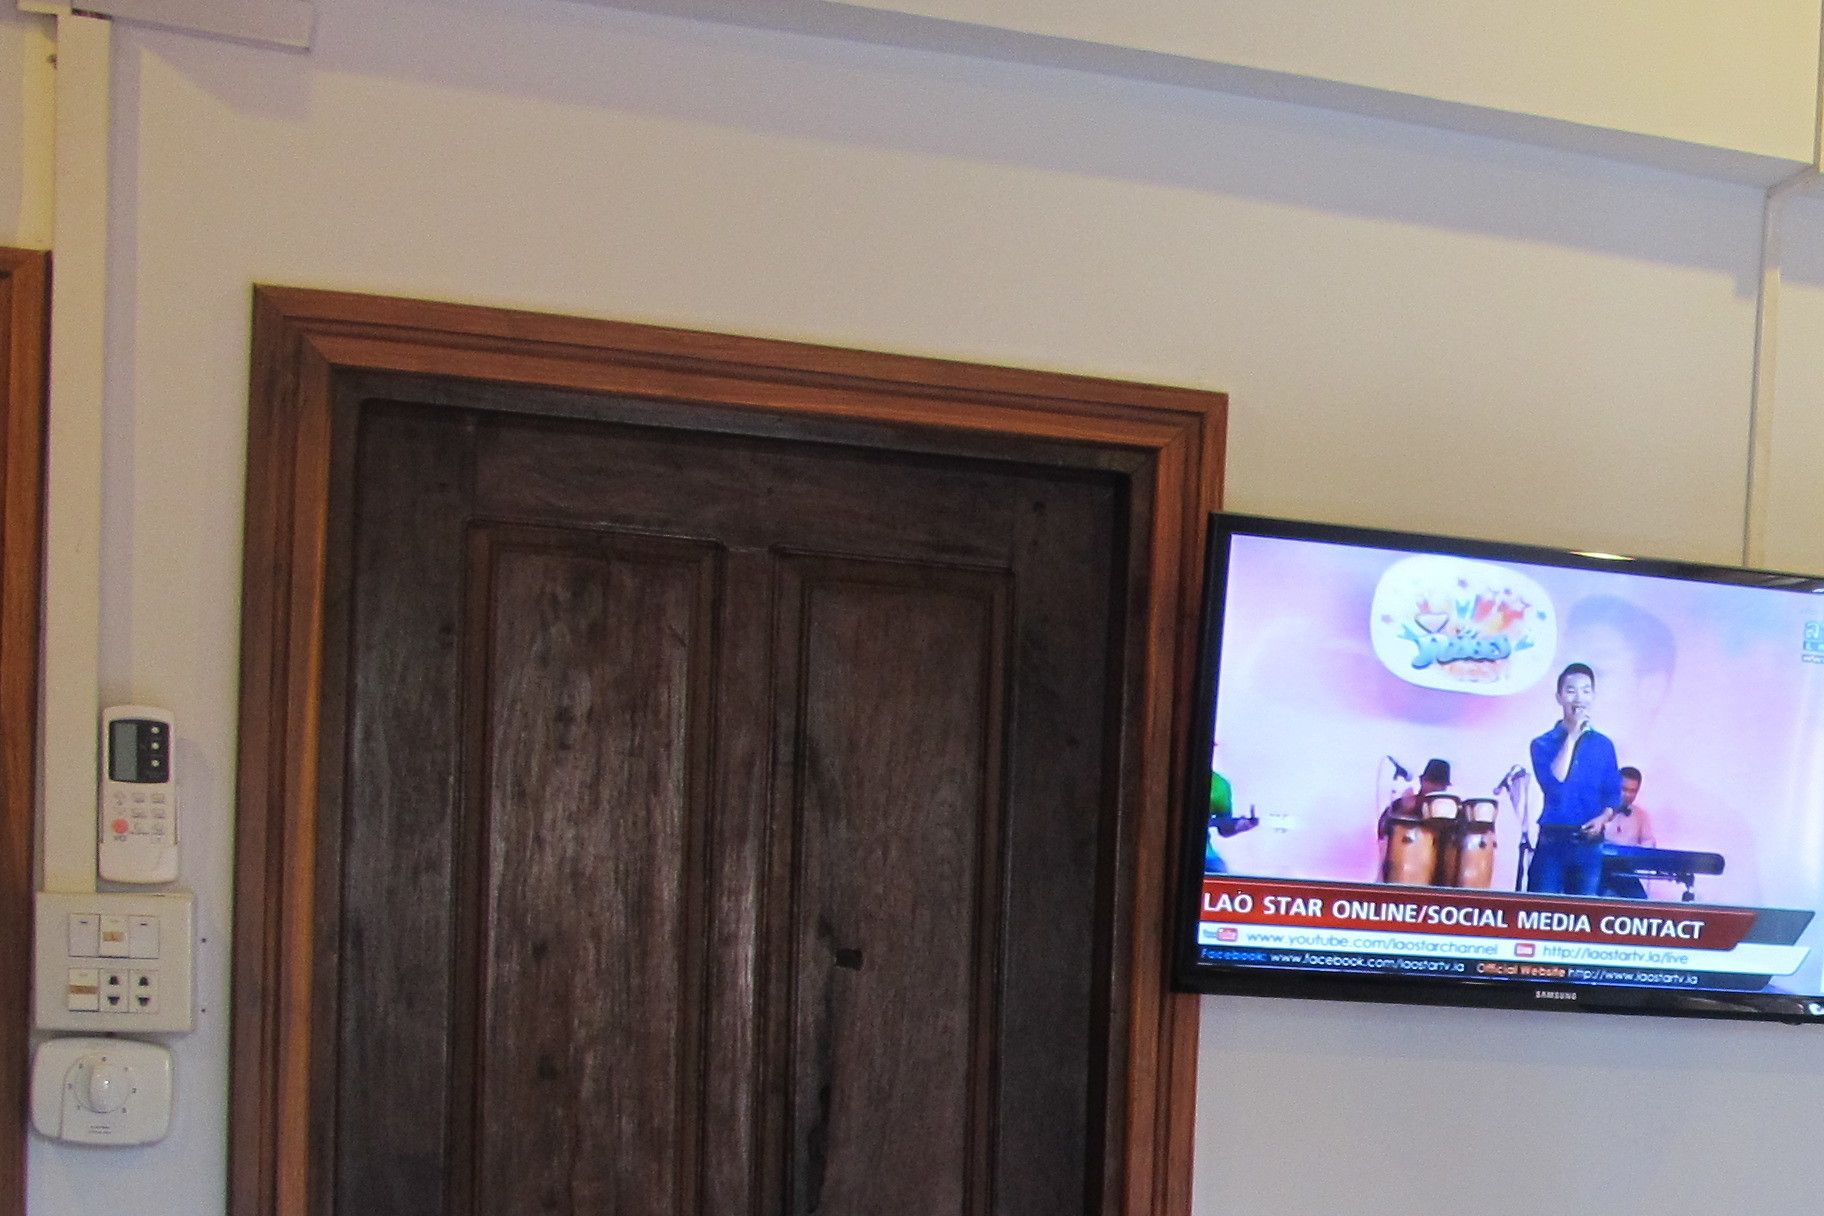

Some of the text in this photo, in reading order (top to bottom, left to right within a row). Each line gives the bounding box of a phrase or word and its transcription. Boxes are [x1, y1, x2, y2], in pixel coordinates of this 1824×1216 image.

[1203, 892, 1705, 940] LAO STAR ONLINE/SOCIAL MEDIA CONTACT
[1246, 933, 1499, 956] www.youtube.com/laostarchannel
[1542, 945, 1689, 965] http://laostartv.la/live
[1270, 951, 1465, 973] www.facebook.com/laostartv.la
[1535, 990, 1577, 1000] SAMSUNG
